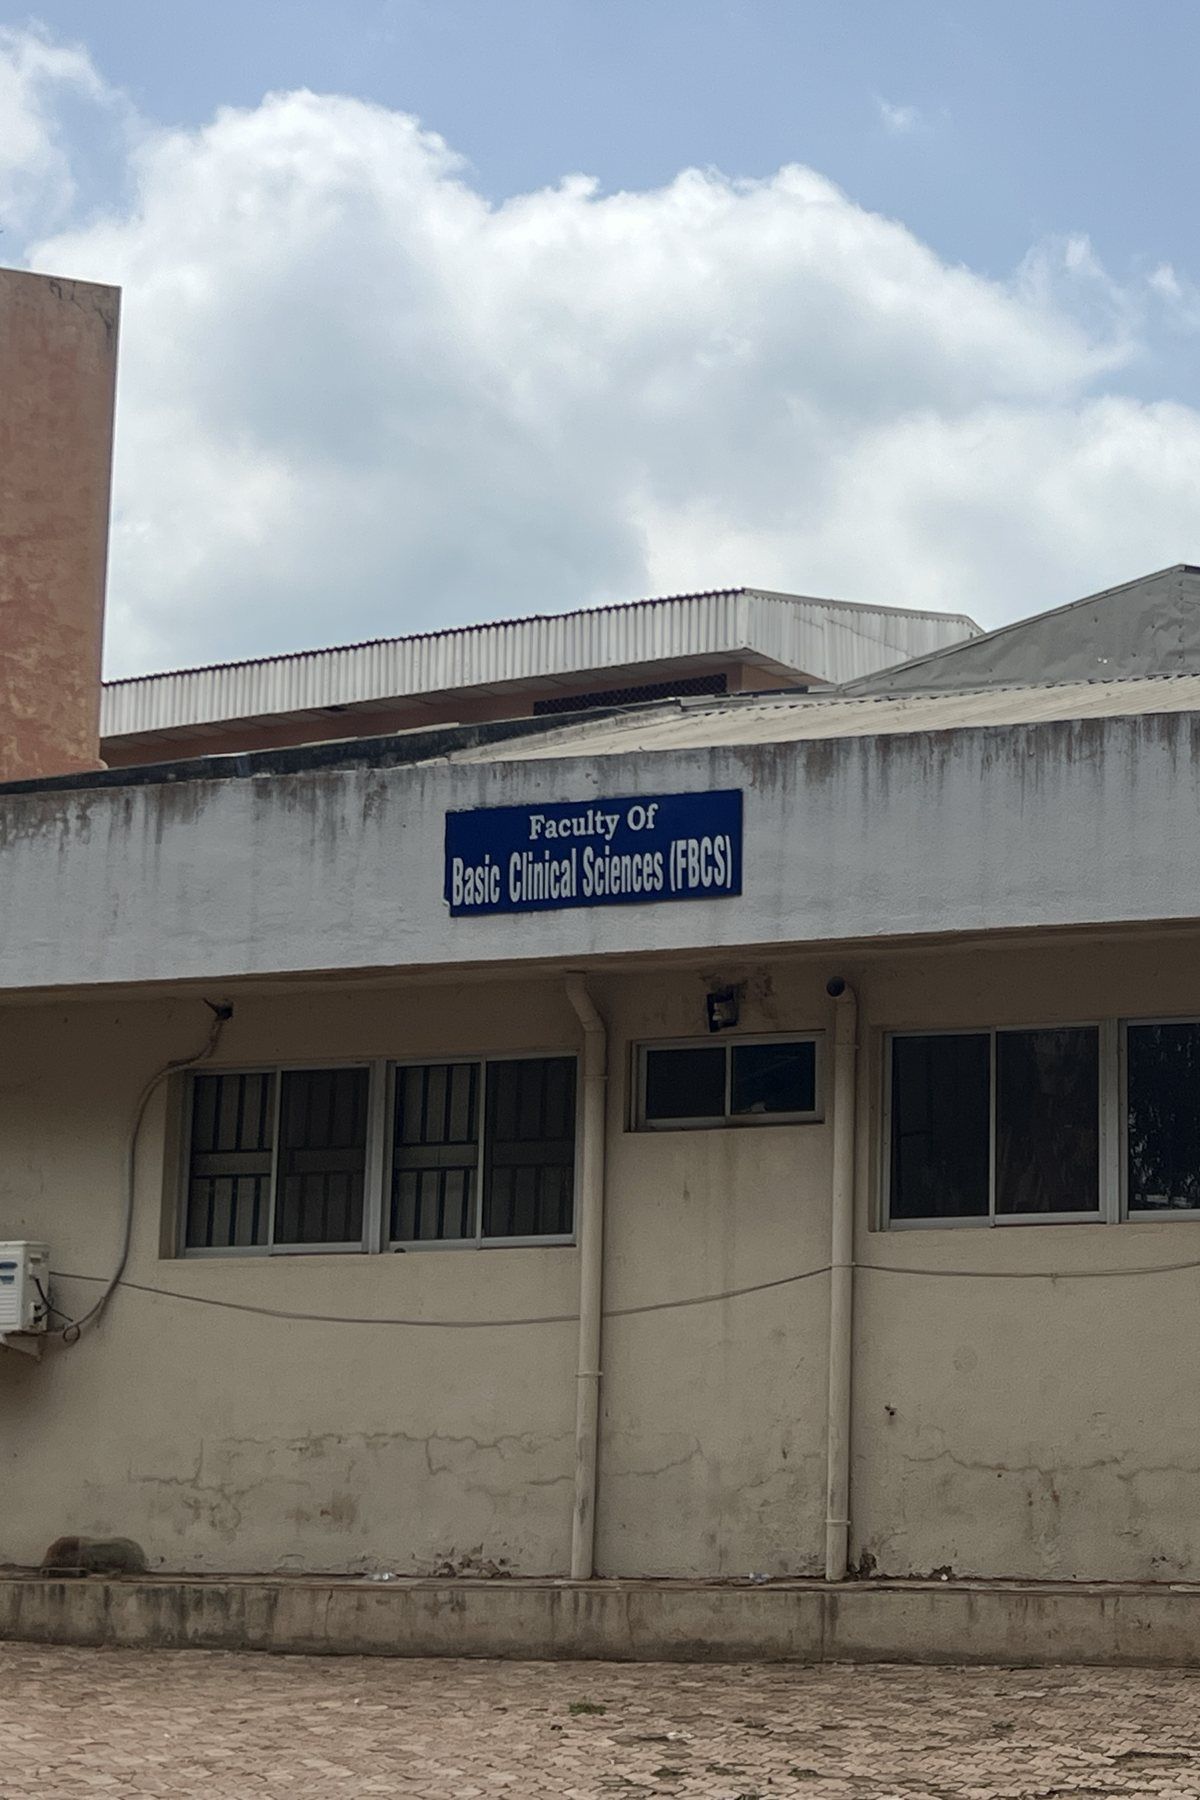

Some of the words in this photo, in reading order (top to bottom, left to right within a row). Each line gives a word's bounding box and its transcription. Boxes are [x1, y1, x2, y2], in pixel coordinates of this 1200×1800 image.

[529, 809, 620, 840] Faculty
[627, 803, 659, 831] Of
[452, 854, 500, 906] Basic
[509, 848, 576, 902] Clinical
[582, 845, 664, 897] Sciences
[670, 835, 732, 891] (FBCS)
